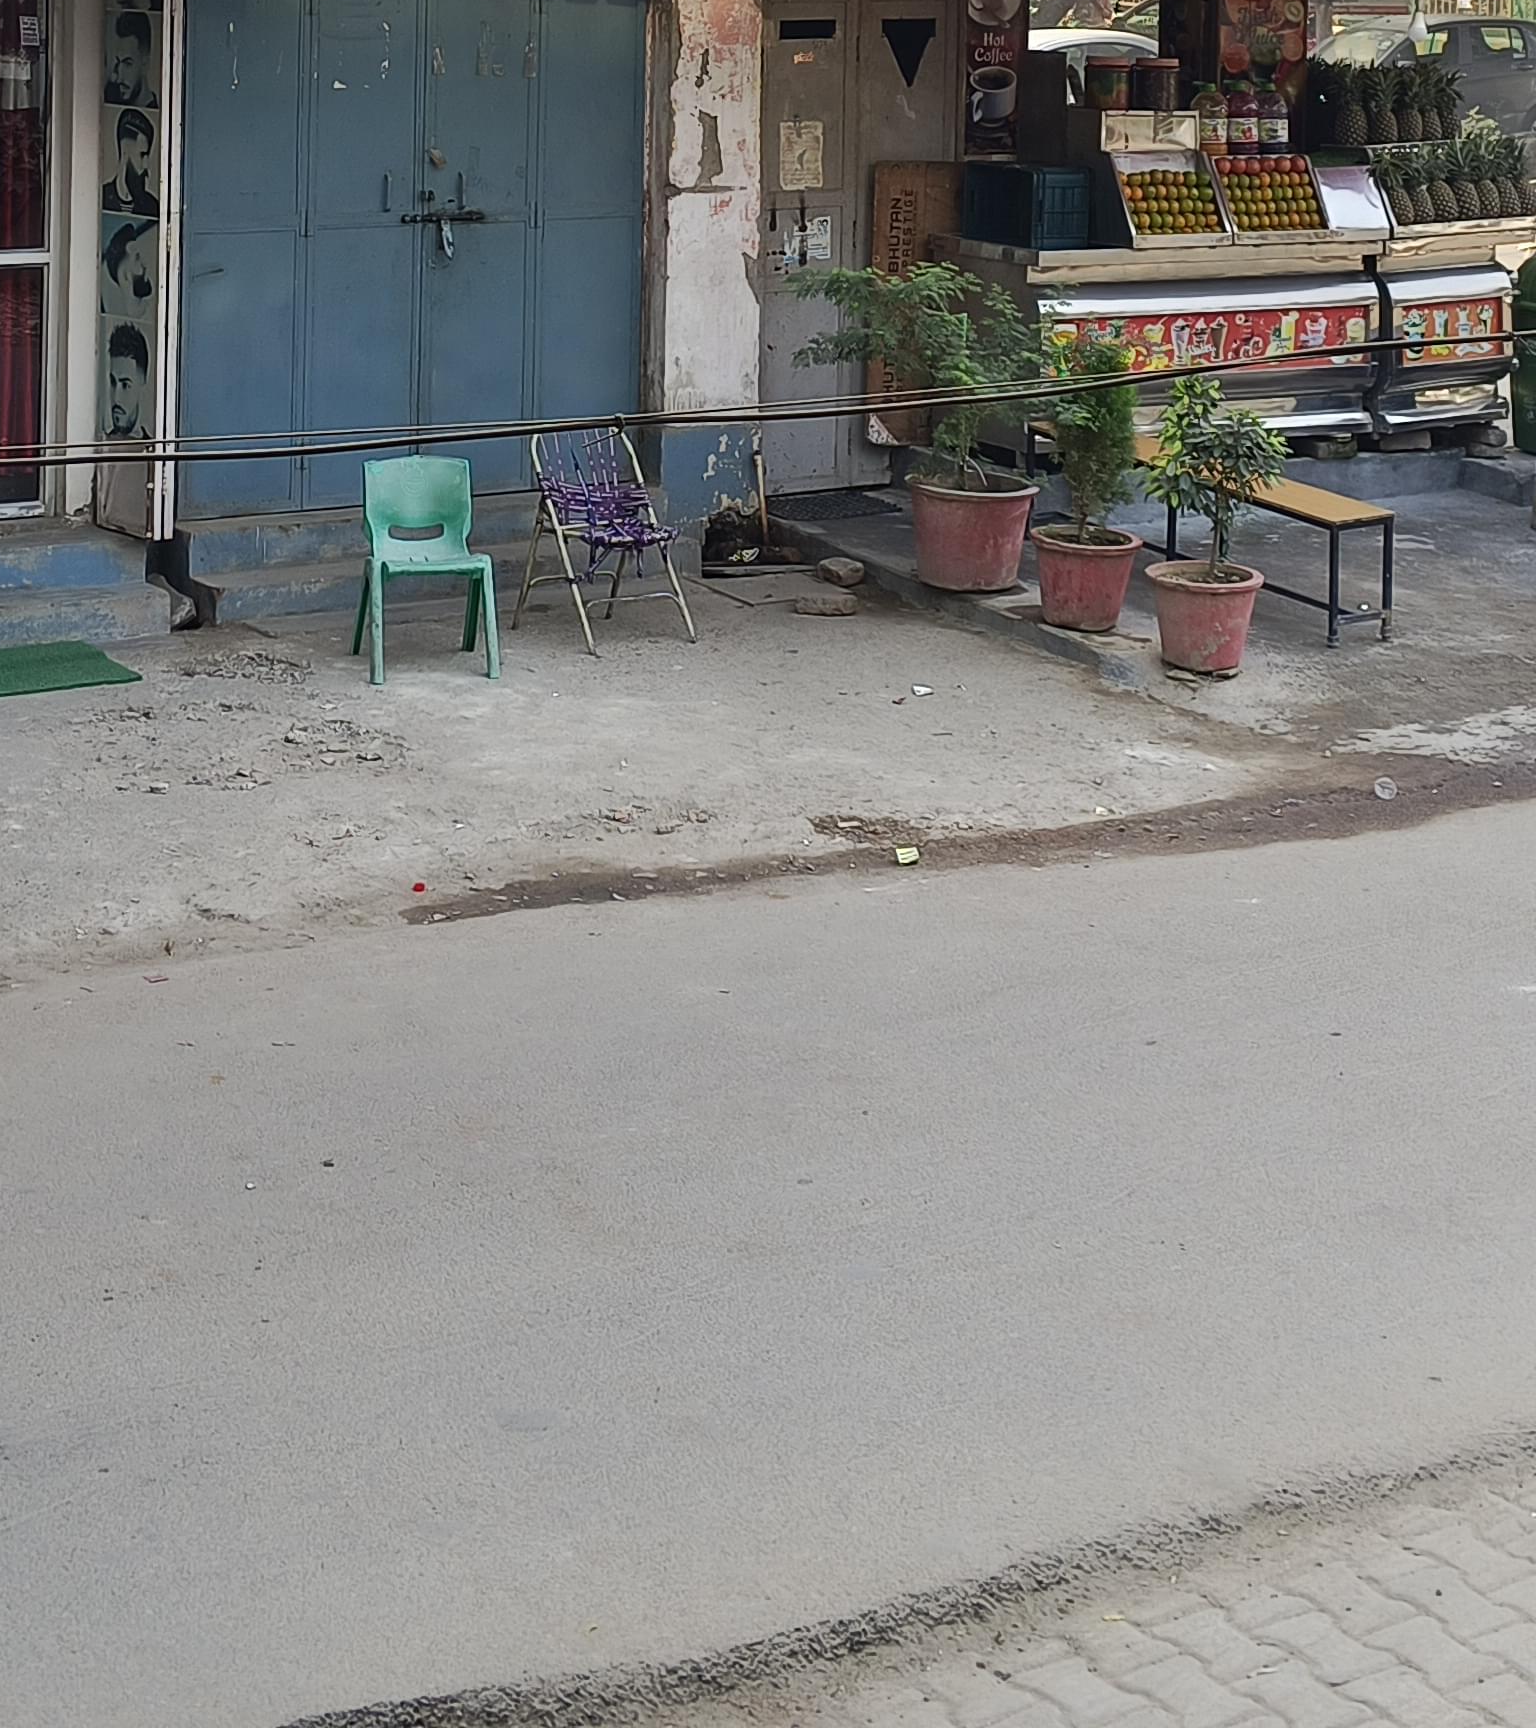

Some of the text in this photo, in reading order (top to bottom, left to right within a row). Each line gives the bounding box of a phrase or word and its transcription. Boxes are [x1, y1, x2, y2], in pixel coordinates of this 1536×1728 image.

[974, 47, 1013, 63] Coffee
[983, 32, 1005, 47] Hot
[887, 197, 903, 274] BHUTAN
[901, 189, 913, 268] PRESTIGE
